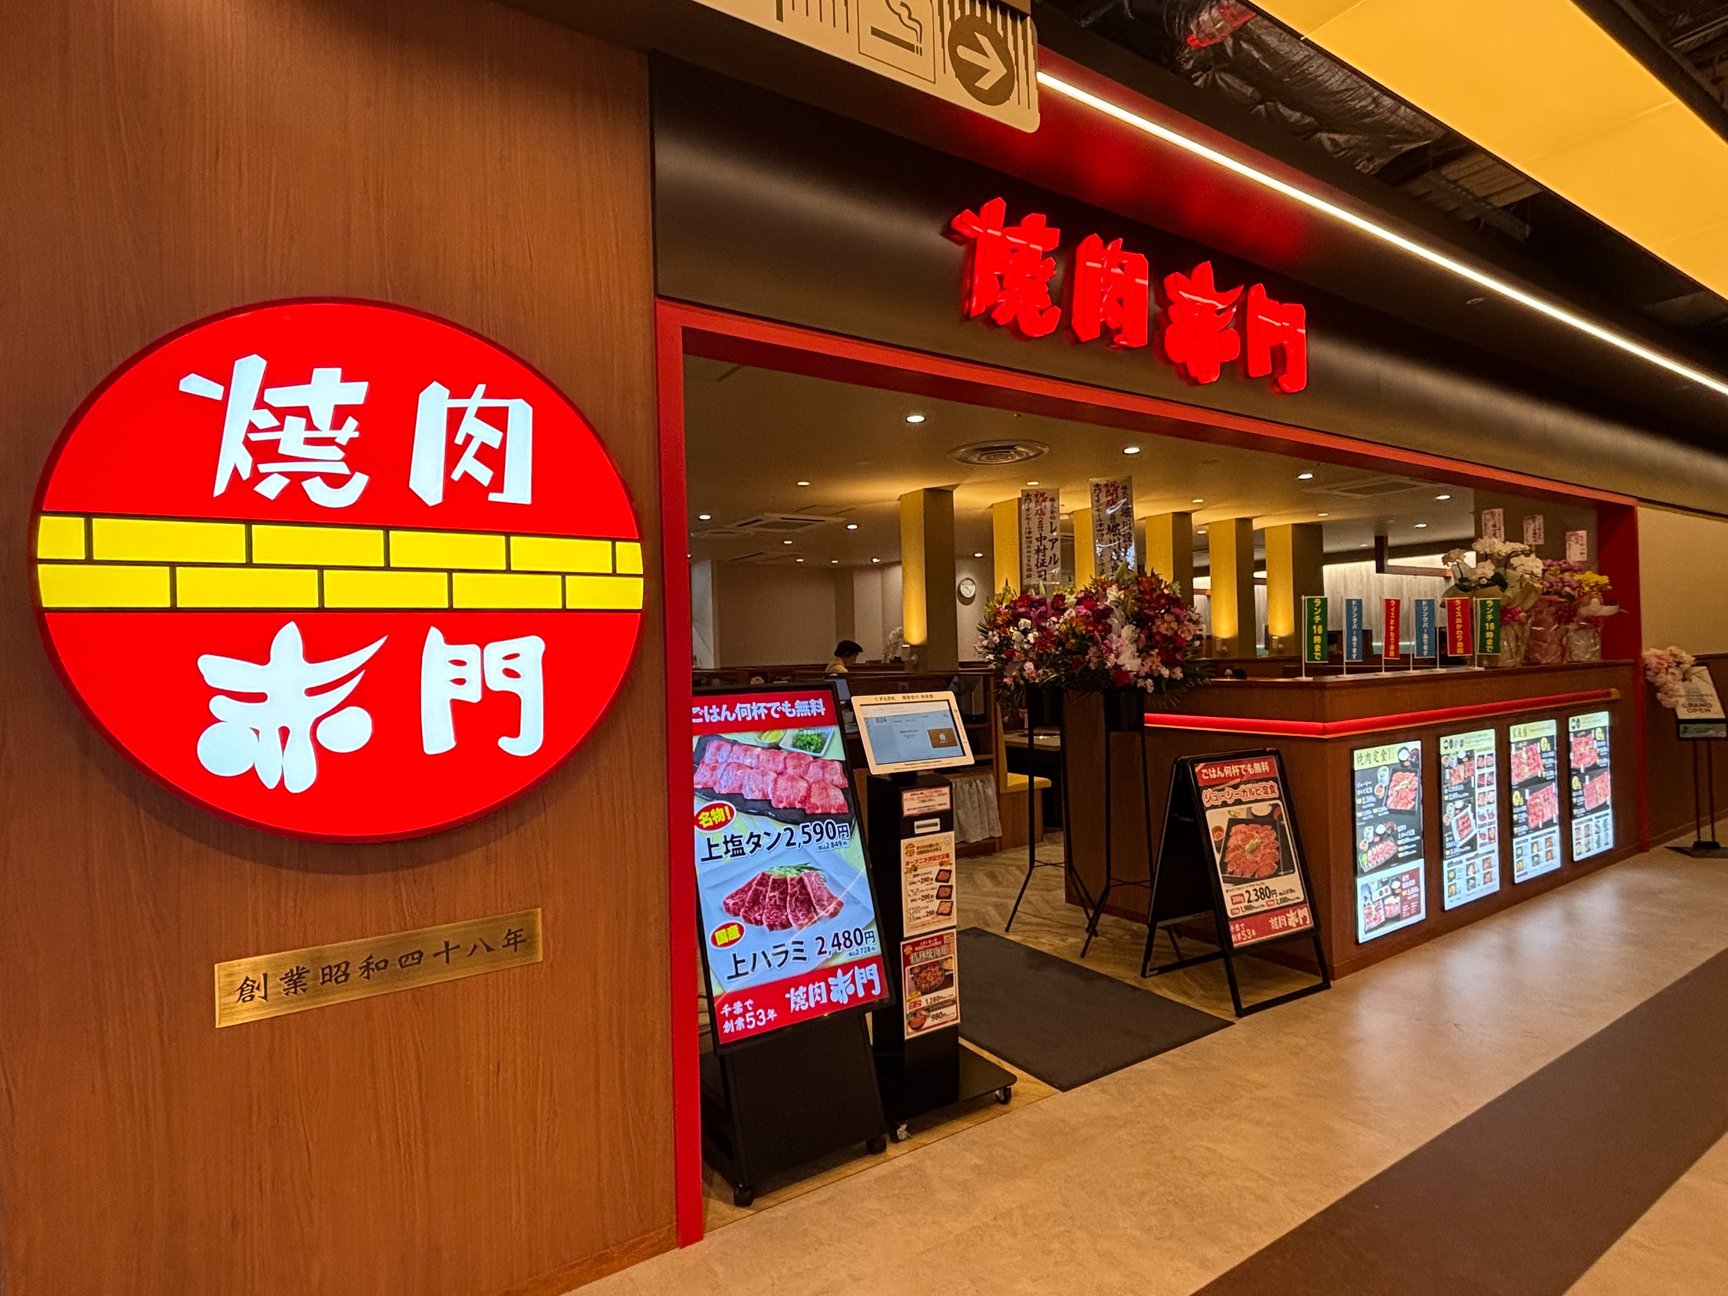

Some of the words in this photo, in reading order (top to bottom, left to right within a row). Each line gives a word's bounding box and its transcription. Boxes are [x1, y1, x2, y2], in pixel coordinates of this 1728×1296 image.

[196, 620, 546, 794] 赤門
[233, 926, 529, 1006] 創業昭和四十八年
[726, 940, 808, 981] 上ハラミ
[815, 926, 876, 957] 2,480円
